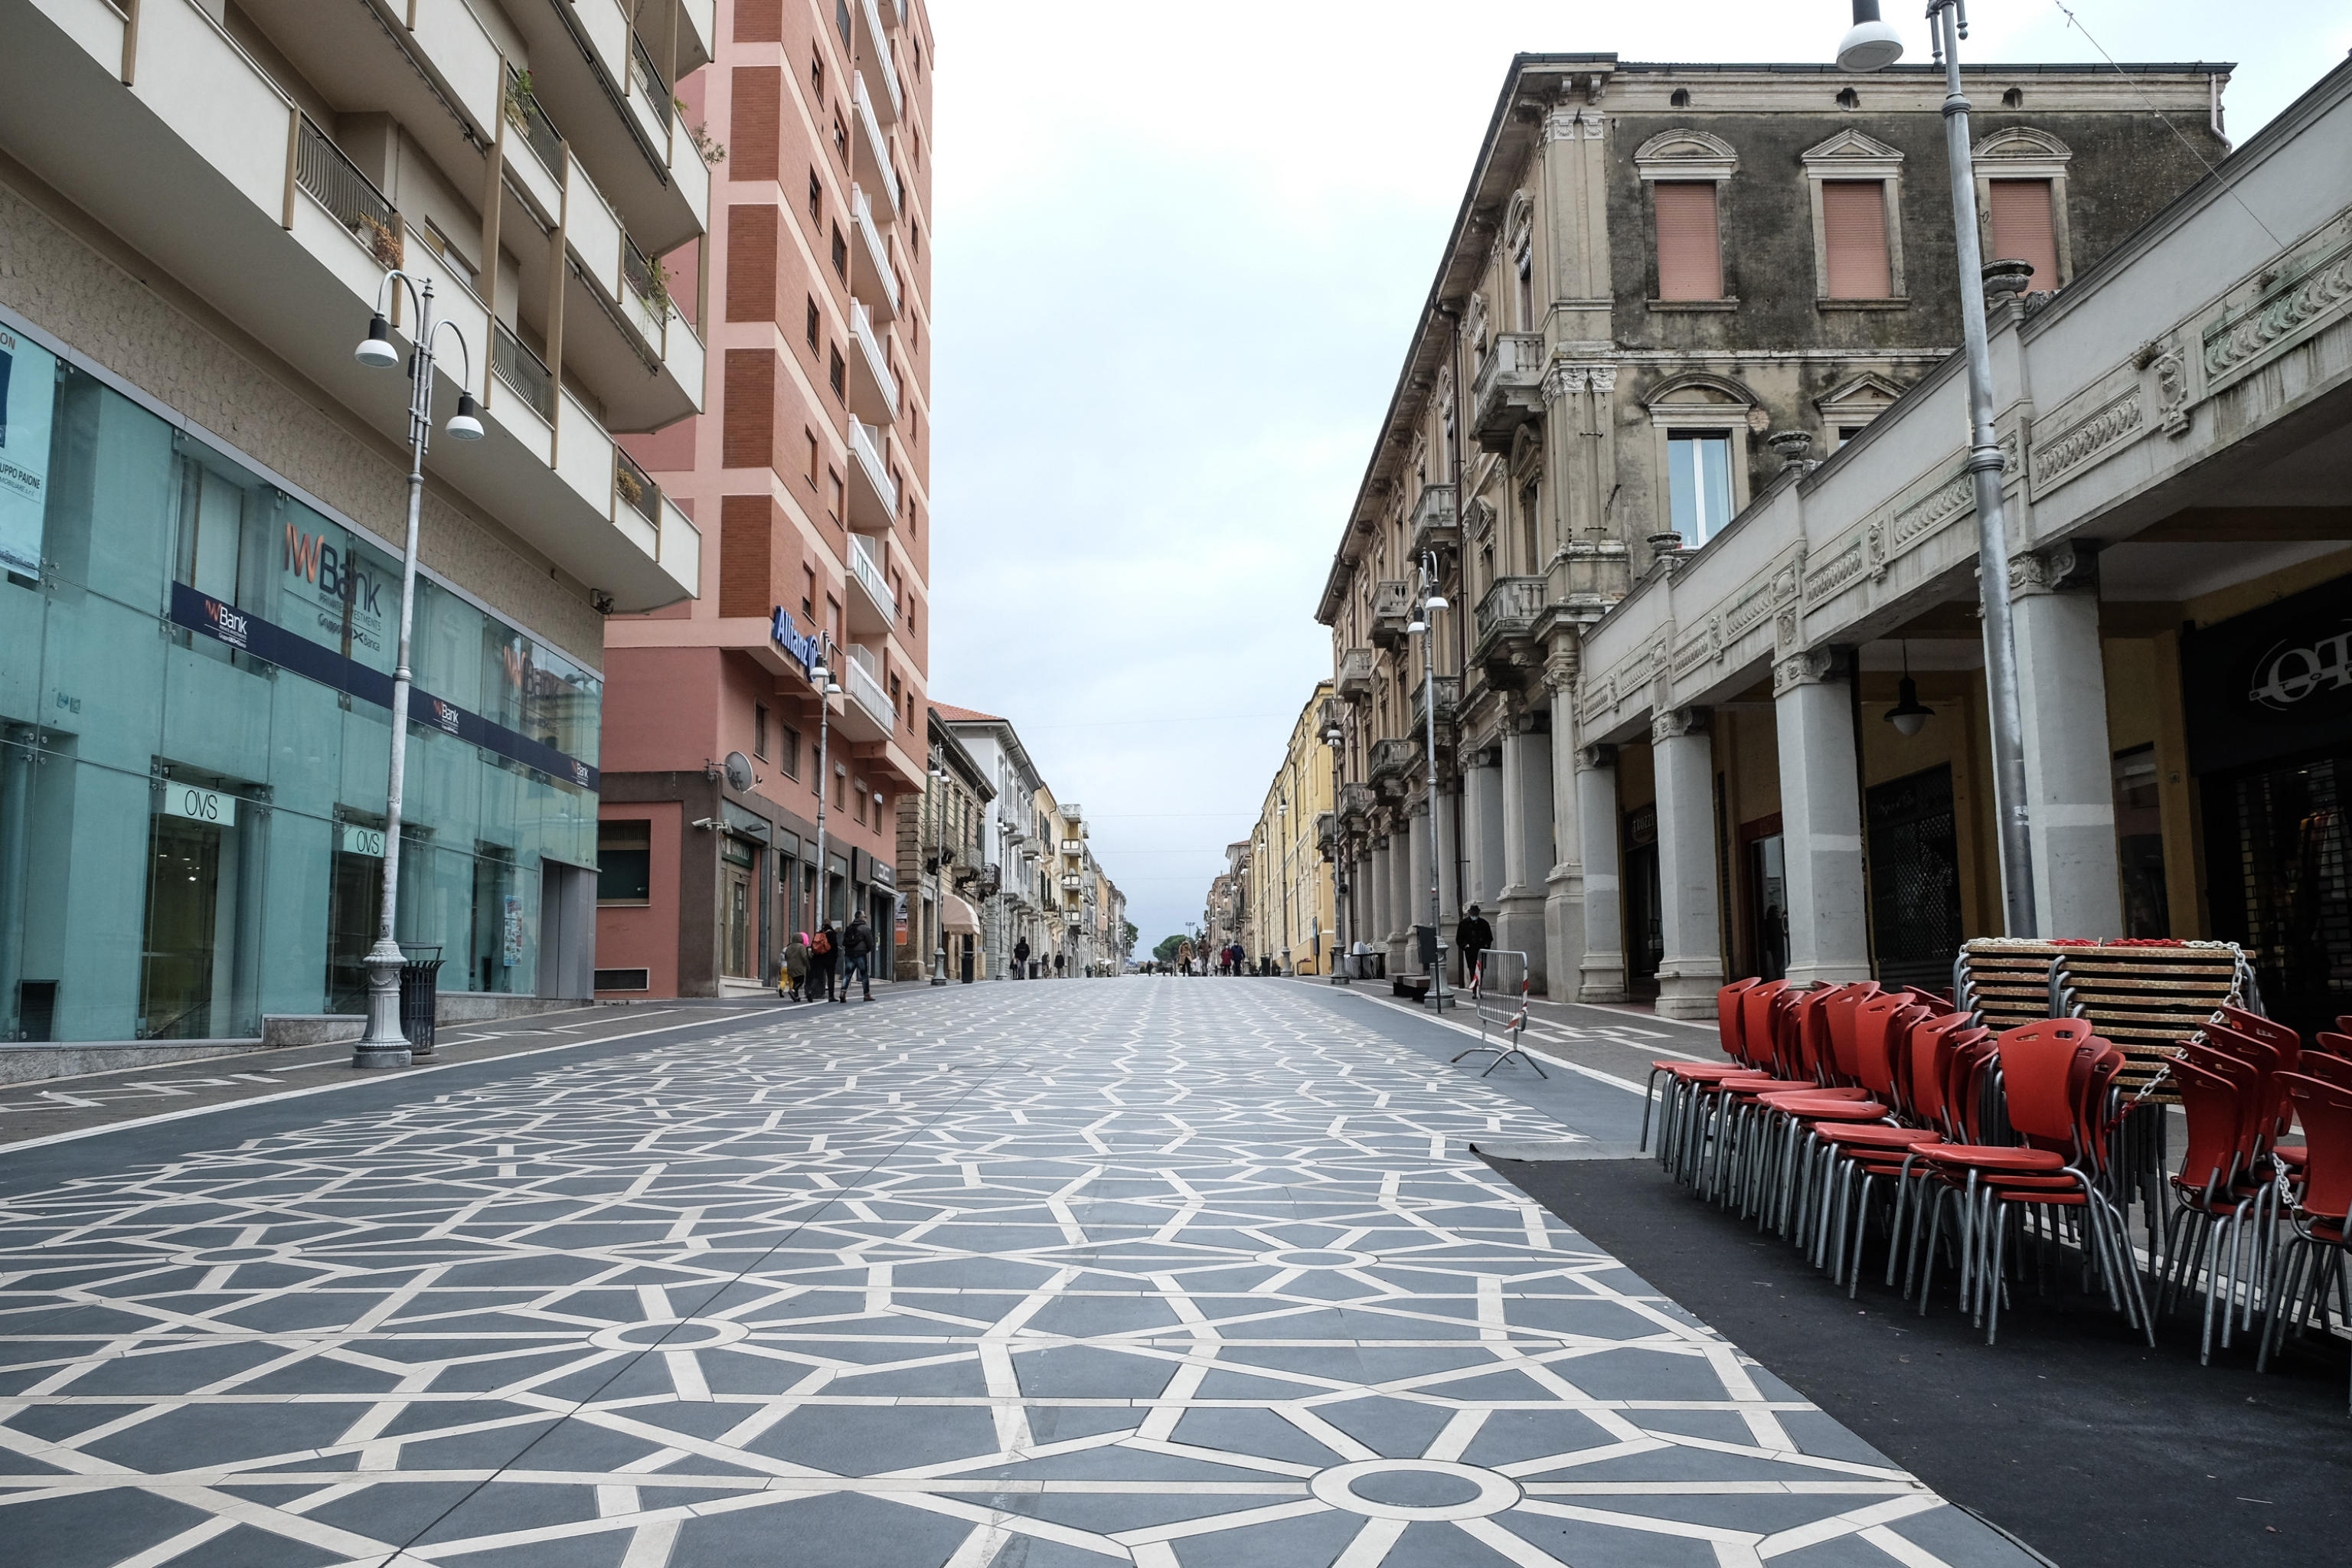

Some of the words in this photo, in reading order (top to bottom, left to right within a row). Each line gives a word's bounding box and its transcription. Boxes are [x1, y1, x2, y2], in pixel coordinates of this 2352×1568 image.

[774, 606, 808, 667] Allianz
[185, 789, 218, 820] OVS
[357, 830, 380, 854] OVS
